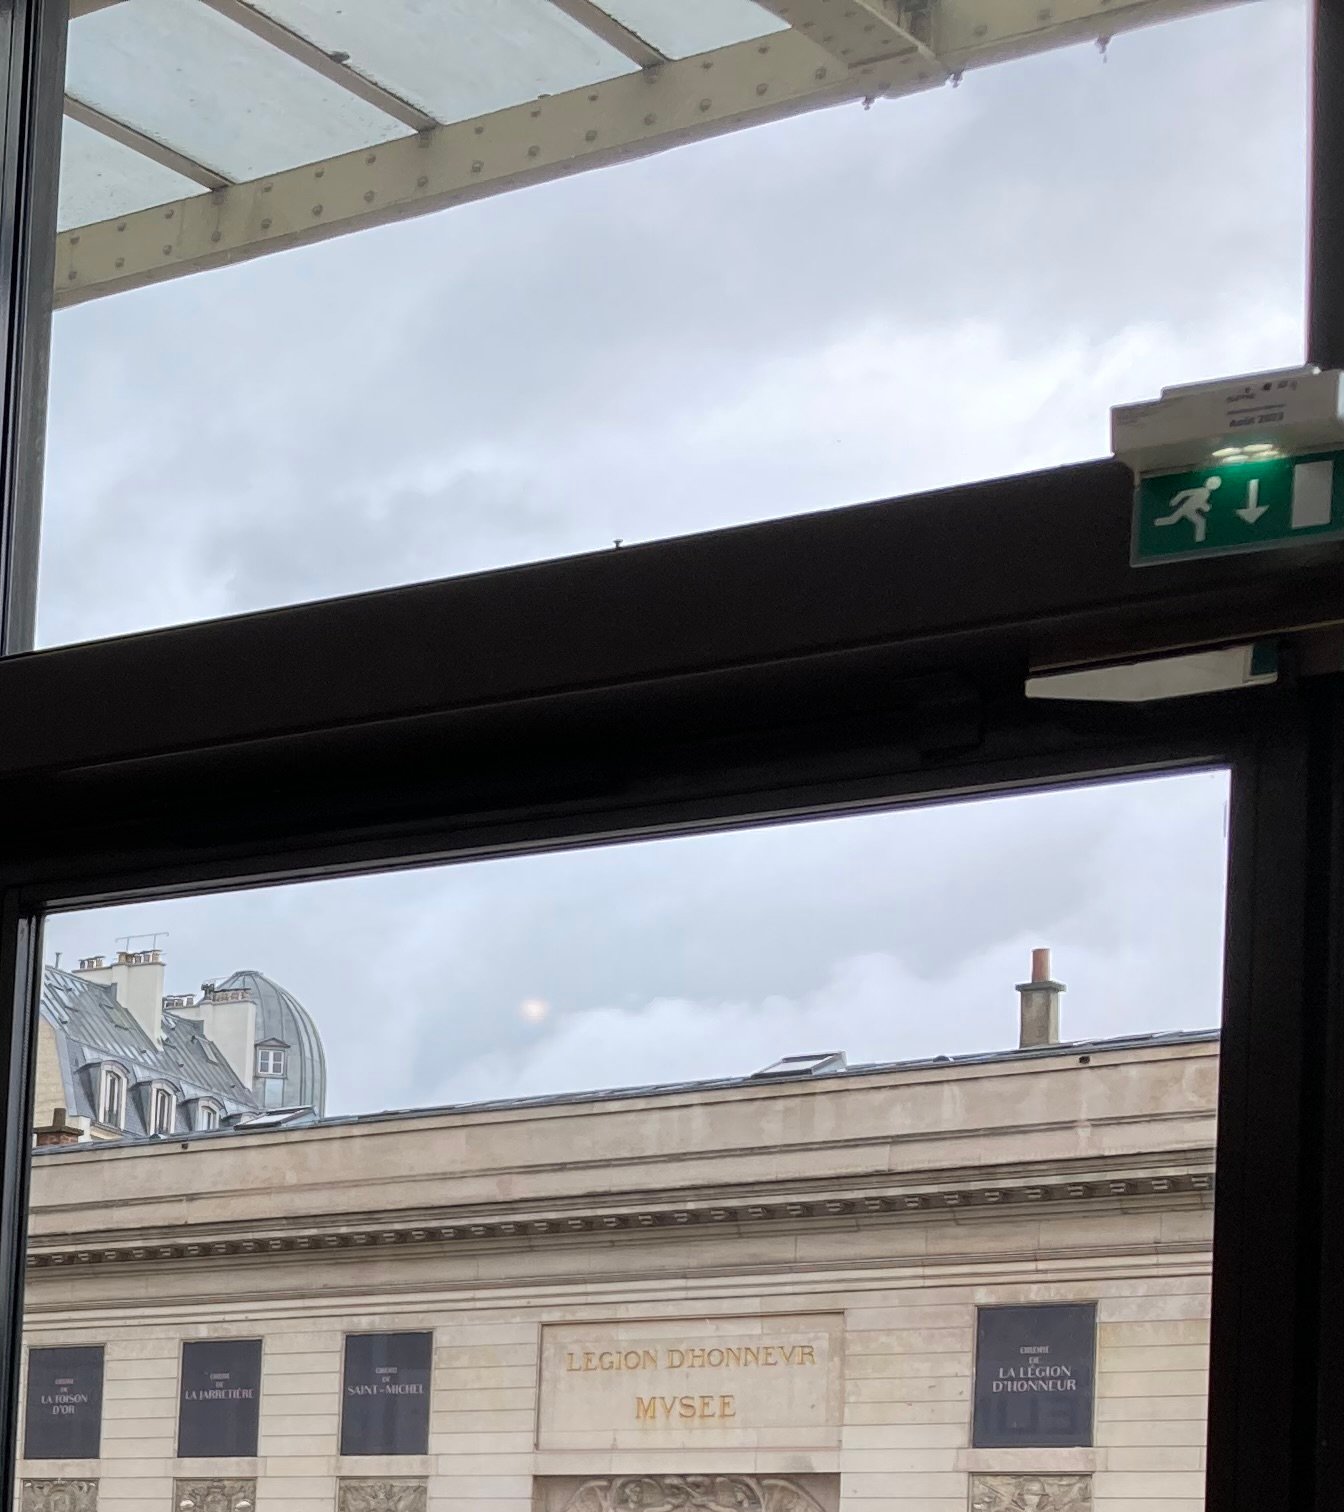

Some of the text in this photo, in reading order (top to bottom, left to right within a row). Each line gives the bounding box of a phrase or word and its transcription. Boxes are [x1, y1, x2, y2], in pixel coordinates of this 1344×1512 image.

[566, 1349, 658, 1372] LEGION
[999, 1367, 1015, 1379] LA
[185, 1390, 197, 1400] LA
[635, 1395, 736, 1419] MVSEE
